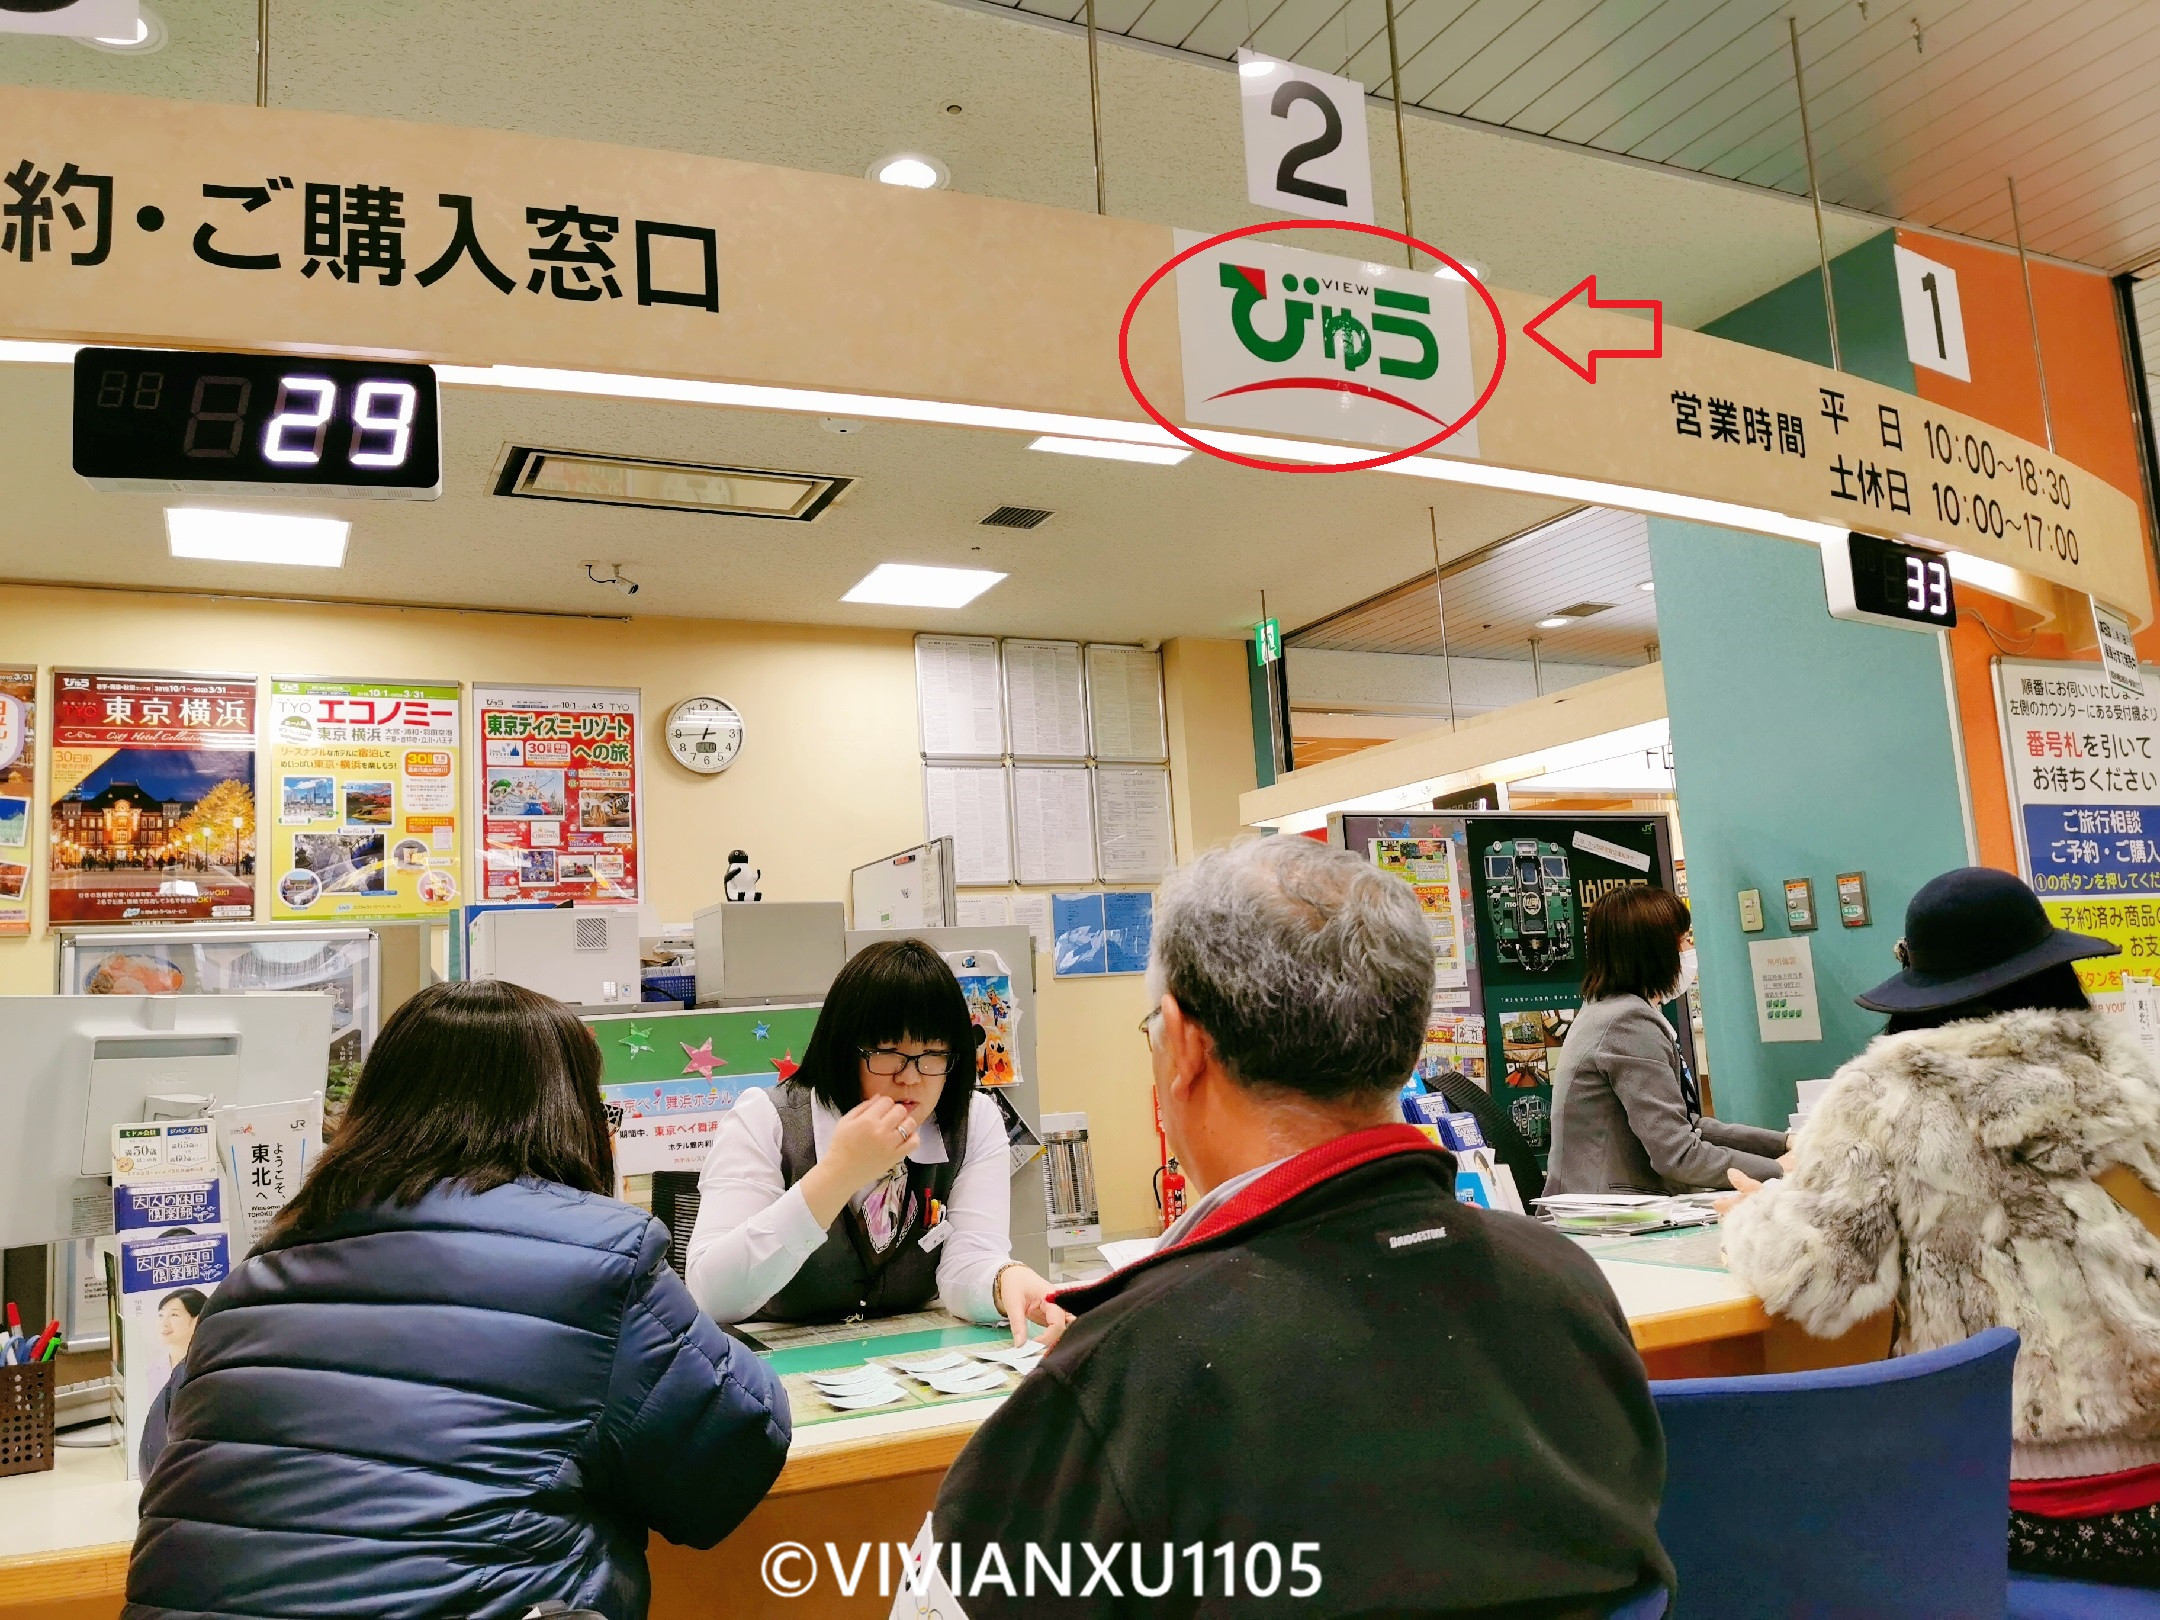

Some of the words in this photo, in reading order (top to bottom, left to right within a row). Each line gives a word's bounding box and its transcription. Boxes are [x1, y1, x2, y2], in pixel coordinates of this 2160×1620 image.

[1271, 80, 1348, 207] 2
[1, 158, 720, 314] 約・ご購入窓口
[1321, 277, 1370, 296] VIEW
[1219, 262, 1440, 381] びゅう
[1921, 271, 1948, 361] 1
[262, 375, 418, 469] 29
[1670, 389, 1807, 459] 営業時間
[1829, 453, 1912, 516] 土休日
[1905, 555, 1949, 617] 33
[64, 704, 98, 718] TYO
[278, 702, 312, 714] TYO
[316, 699, 453, 728] エコノミー
[609, 702, 630, 712] TYO
[486, 713, 629, 739] 東京ディズニーリゾート
[573, 742, 630, 763] への旅
[2026, 730, 2152, 759] 番号札を引いて
[2032, 765, 2157, 793] お待ちください
[2063, 808, 2143, 834] ご旅行相談
[2105, 1002, 2126, 1014] your
[290, 1119, 306, 1129] JR
[251, 1143, 272, 1200] 東北へ
[273, 1143, 286, 1199] ようこそ、
[132, 1191, 207, 1210] 大人の休日
[136, 1248, 214, 1272] 大人の休日
